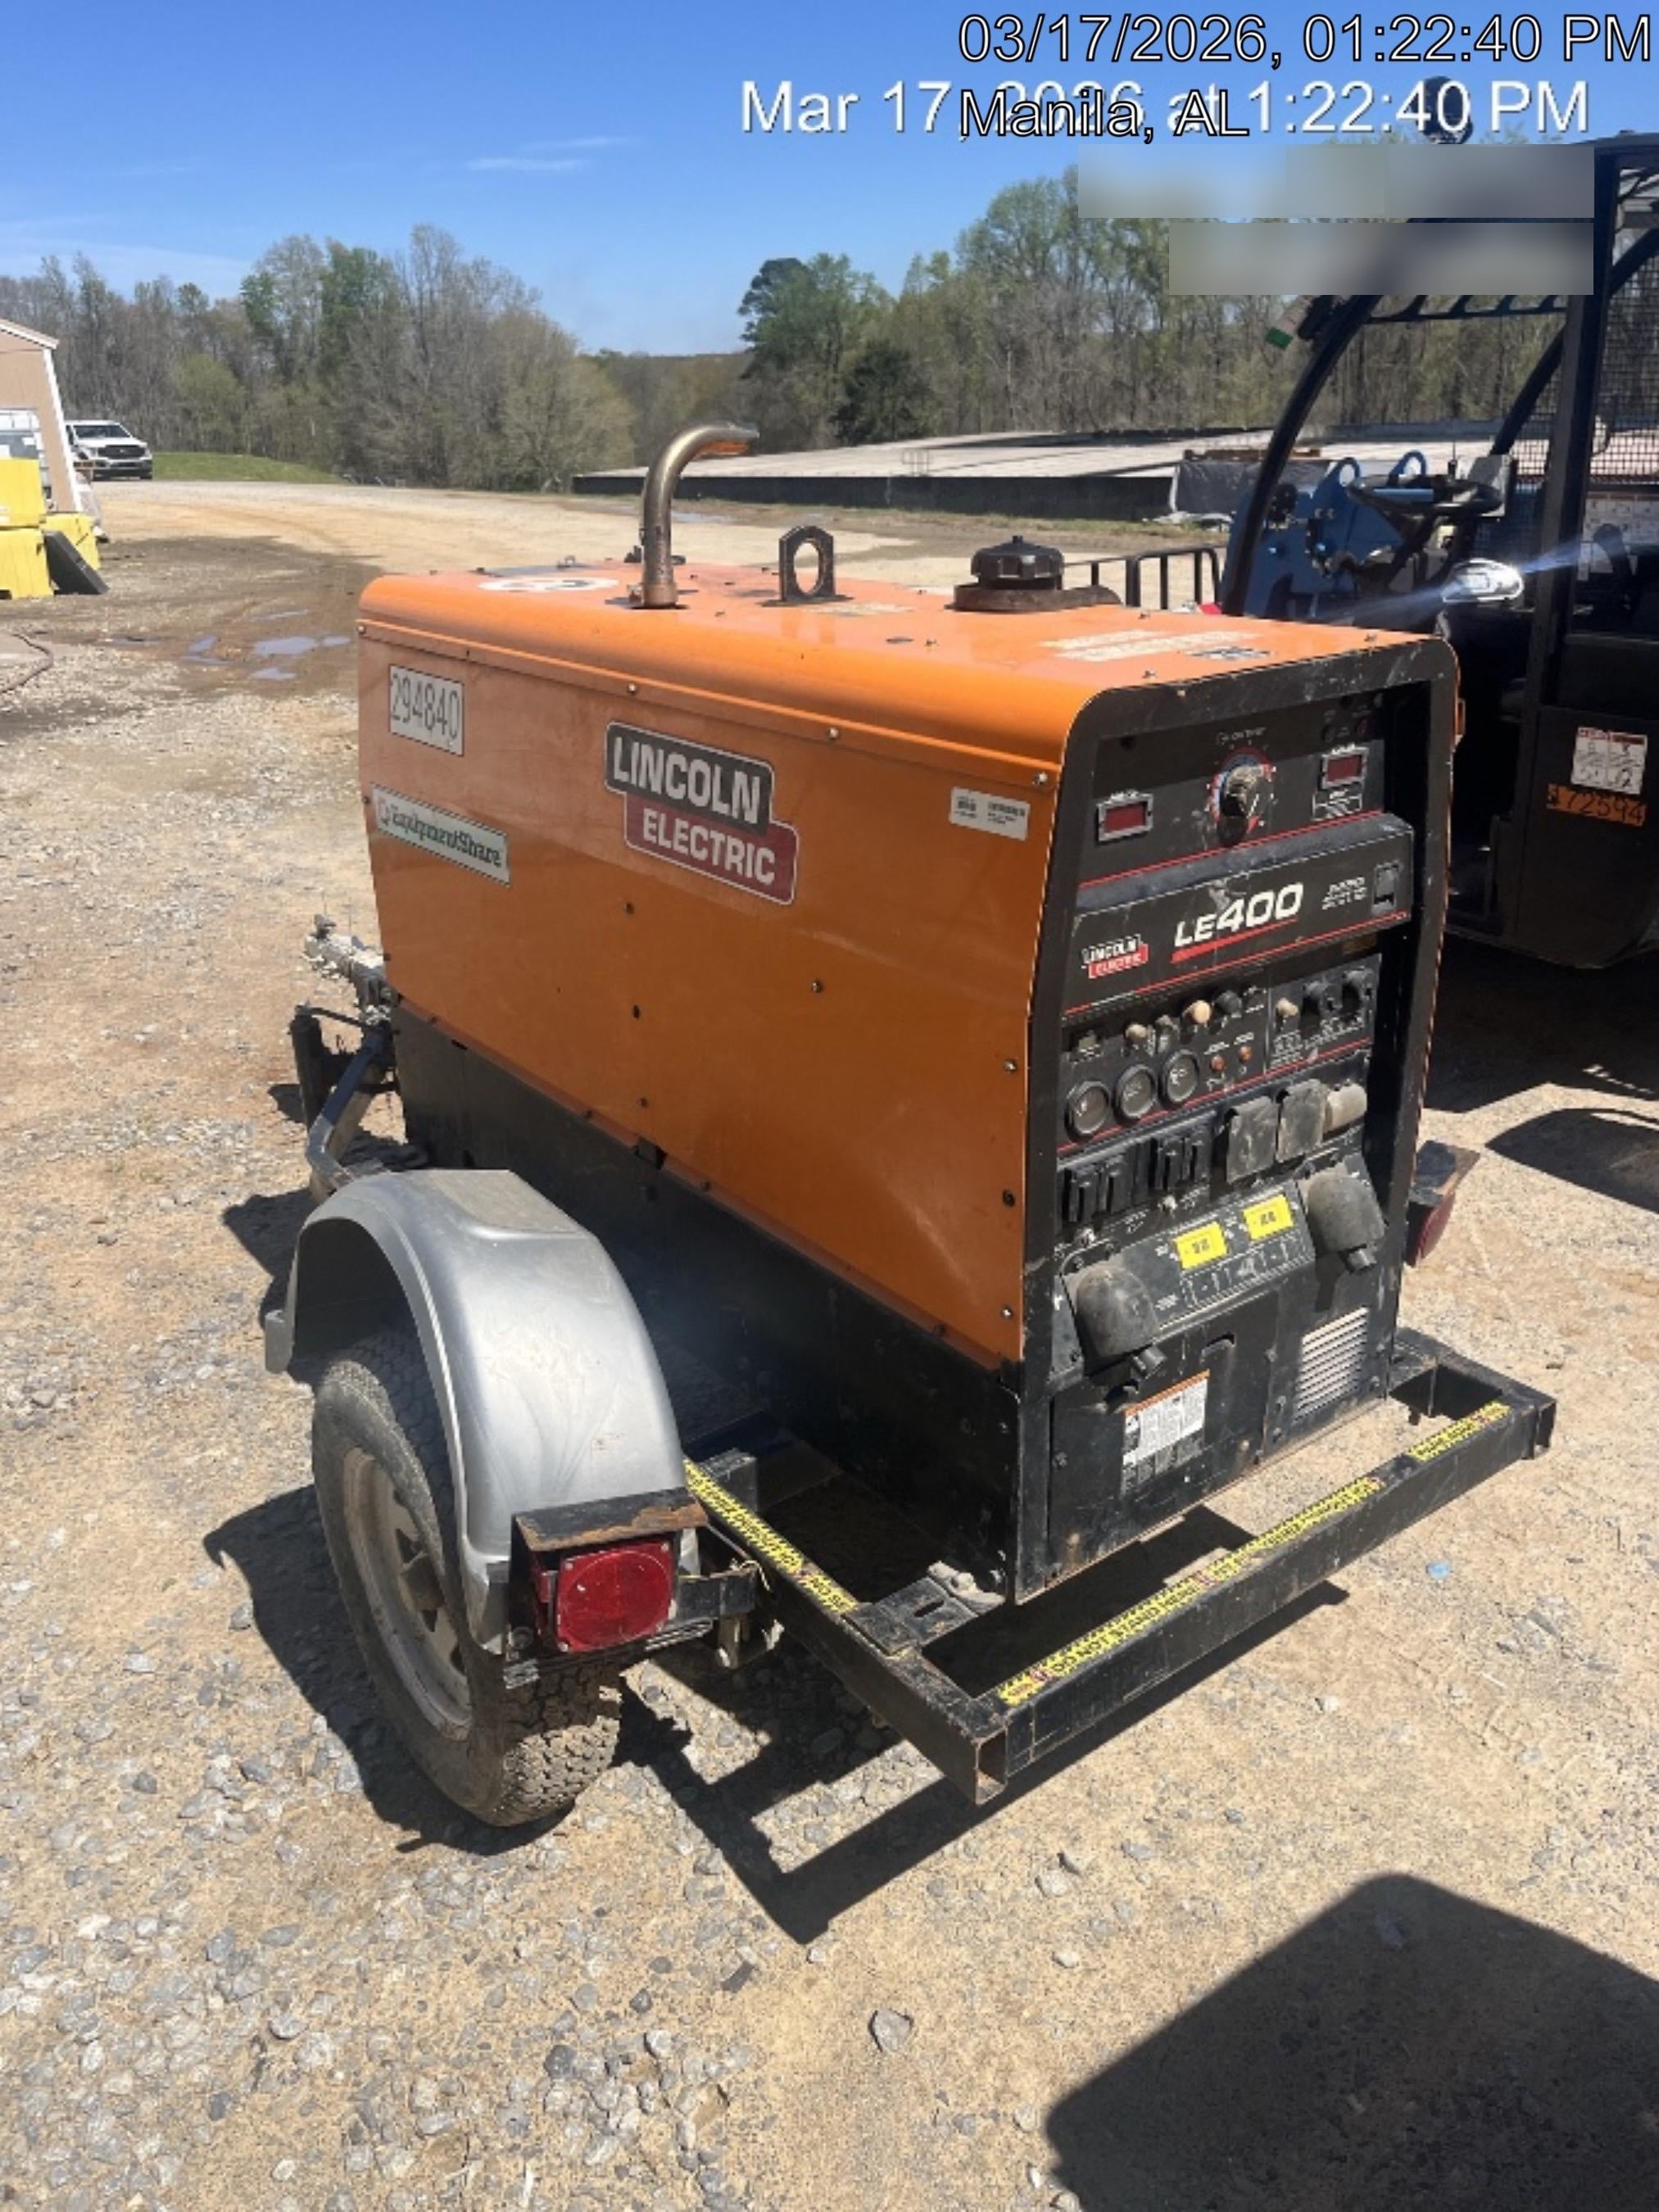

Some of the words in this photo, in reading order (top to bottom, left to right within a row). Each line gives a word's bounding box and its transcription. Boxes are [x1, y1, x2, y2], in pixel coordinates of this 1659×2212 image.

[391, 672, 460, 741] 294840
[614, 737, 761, 824] LINCOLN
[642, 808, 775, 886] ELECTRIC
[1174, 882, 1304, 948] LE400
